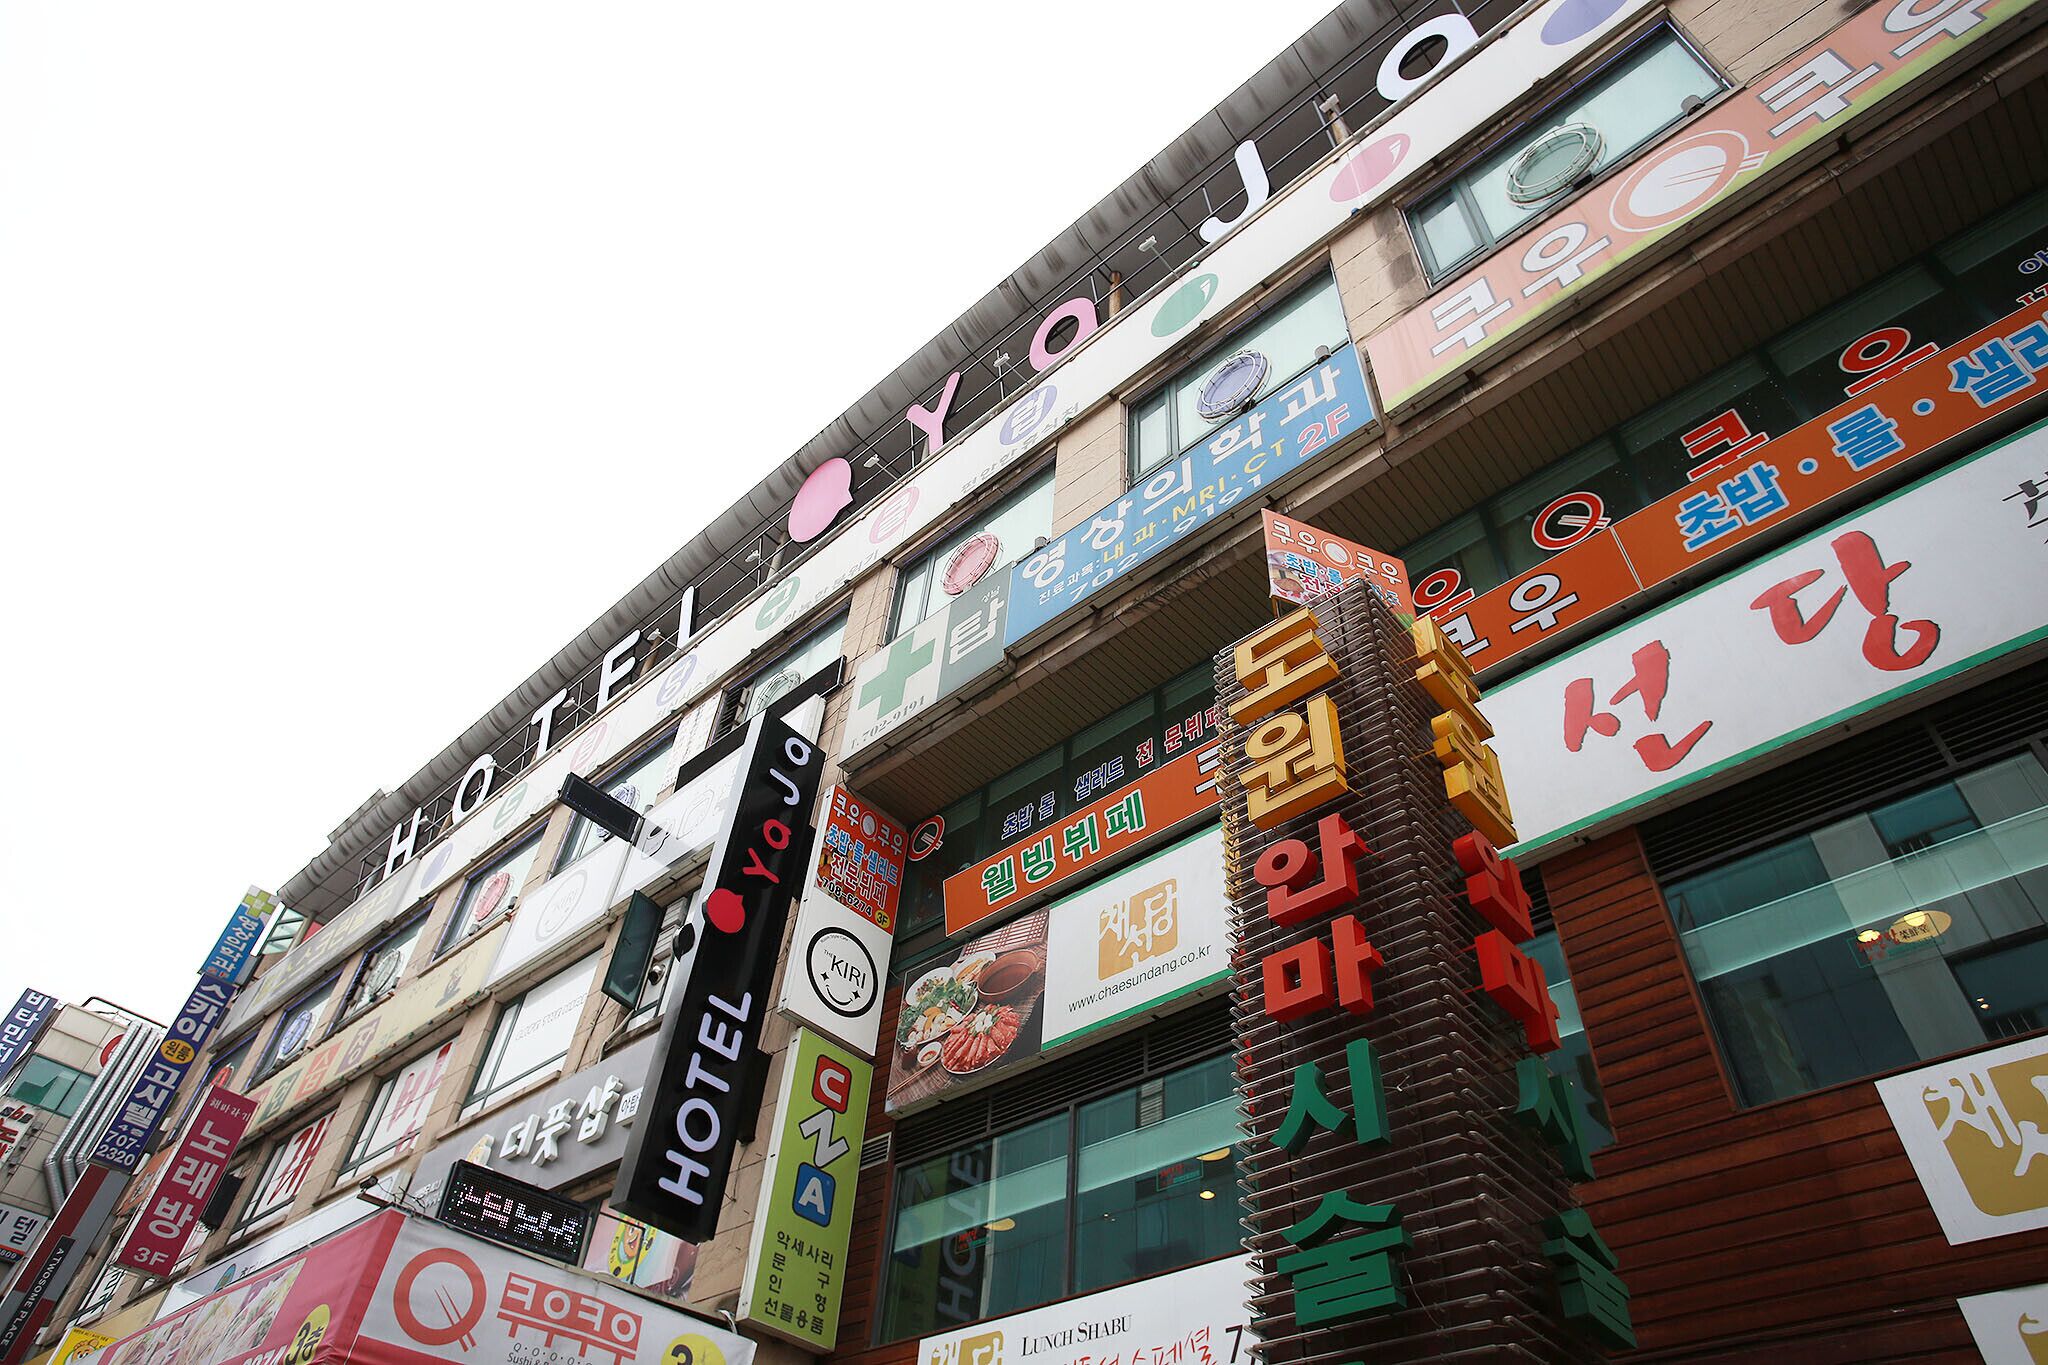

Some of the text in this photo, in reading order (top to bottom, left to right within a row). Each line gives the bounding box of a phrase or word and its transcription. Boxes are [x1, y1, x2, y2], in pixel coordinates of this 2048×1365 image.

[1429, 222, 1613, 358] 쿠우
[1297, 403, 1352, 458] 2F
[1022, 366, 1342, 590] 영상의학과
[1068, 472, 1265, 604] 702-9191
[1271, 519, 1321, 555] 쿠우
[862, 694, 926, 737] 702-9191
[1226, 605, 1355, 832] 도원
[833, 793, 905, 856] 쿠우 쿠우
[1001, 802, 1035, 841] 초밥
[1038, 791, 1056, 821] 롤
[1074, 755, 1125, 801] 샐러드
[980, 788, 1147, 906] 웰빙뷔페
[821, 878, 874, 919] 708-6274
[829, 853, 889, 911] 전문뷔페
[875, 910, 891, 928] 3F
[830, 954, 867, 990] KIRI
[1068, 944, 1212, 1013] www.chaesundang.co.kr
[176, 983, 227, 1043] 스카이
[121, 1062, 182, 1130] 고시텔
[499, 1074, 624, 1168] 더풋샵
[657, 991, 753, 1206] HOTEL
[96, 1145, 136, 1167] 2320
[148, 1119, 231, 1240] 노래방
[133, 1246, 170, 1267] 3F
[776, 1230, 835, 1271] 악세사리
[24, 1254, 63, 1310] TWOSOME
[0, 1311, 29, 1347] PLACE
[763, 1296, 825, 1337] 선물용품
[1021, 1329, 1074, 1357] LUNCH
[1077, 1314, 1133, 1345] SHABU
